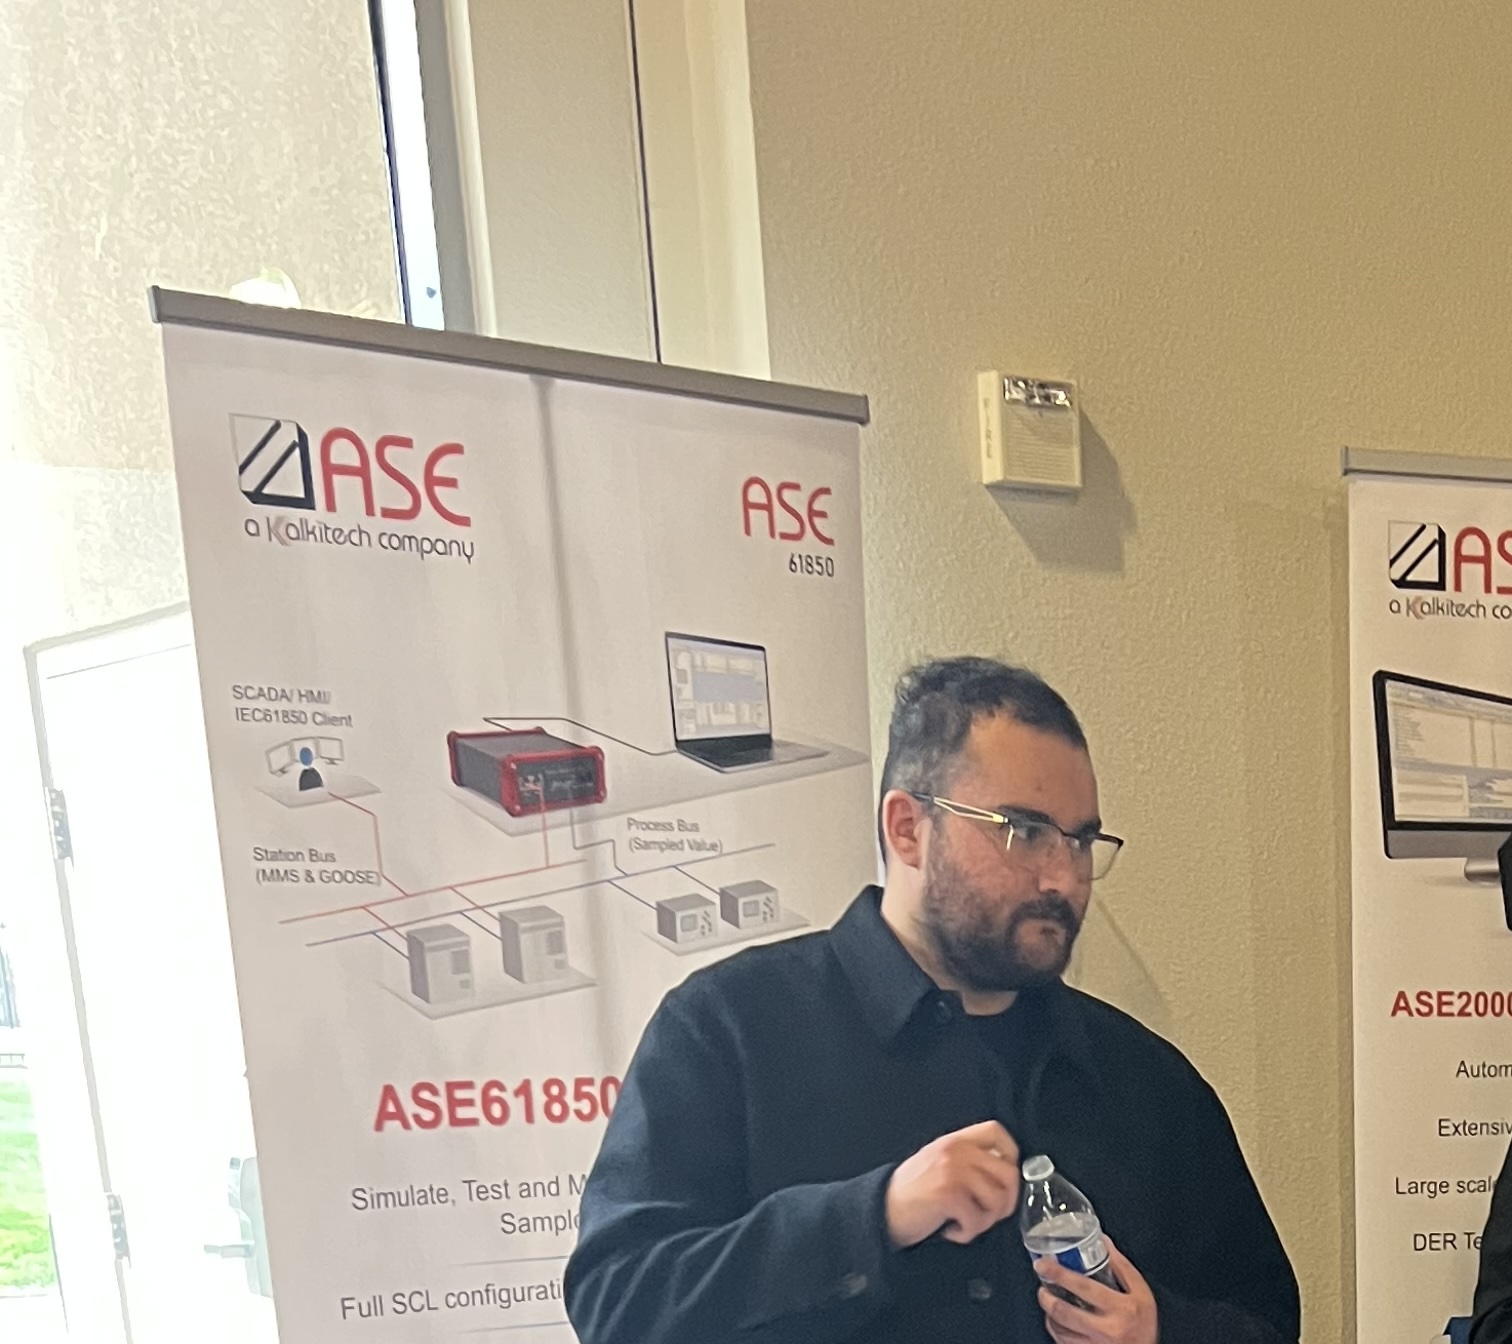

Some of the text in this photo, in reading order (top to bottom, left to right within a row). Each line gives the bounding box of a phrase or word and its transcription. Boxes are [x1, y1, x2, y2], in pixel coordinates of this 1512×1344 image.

[319, 426, 472, 527] ASE
[742, 475, 835, 546] ASE
[244, 515, 475, 564] a Kalkitech company
[788, 551, 835, 578] 61850
[1389, 599, 1401, 614] a
[1405, 595, 1487, 620] Kalkitech
[235, 707, 354, 728] IEC61850 Client
[627, 817, 700, 833] Process Bus
[253, 846, 336, 863] Station Bus
[628, 836, 685, 854] (Sampled
[255, 867, 382, 887] (MMS & GOOSE)
[374, 1075, 623, 1133] ASE61850
[351, 1184, 457, 1212] Simulate,
[462, 1179, 511, 1202] Test
[518, 1175, 560, 1199] and
[1395, 1176, 1450, 1199] Large
[1413, 1232, 1457, 1251] DER
[340, 1278, 562, 1320] Full SCL configurati
